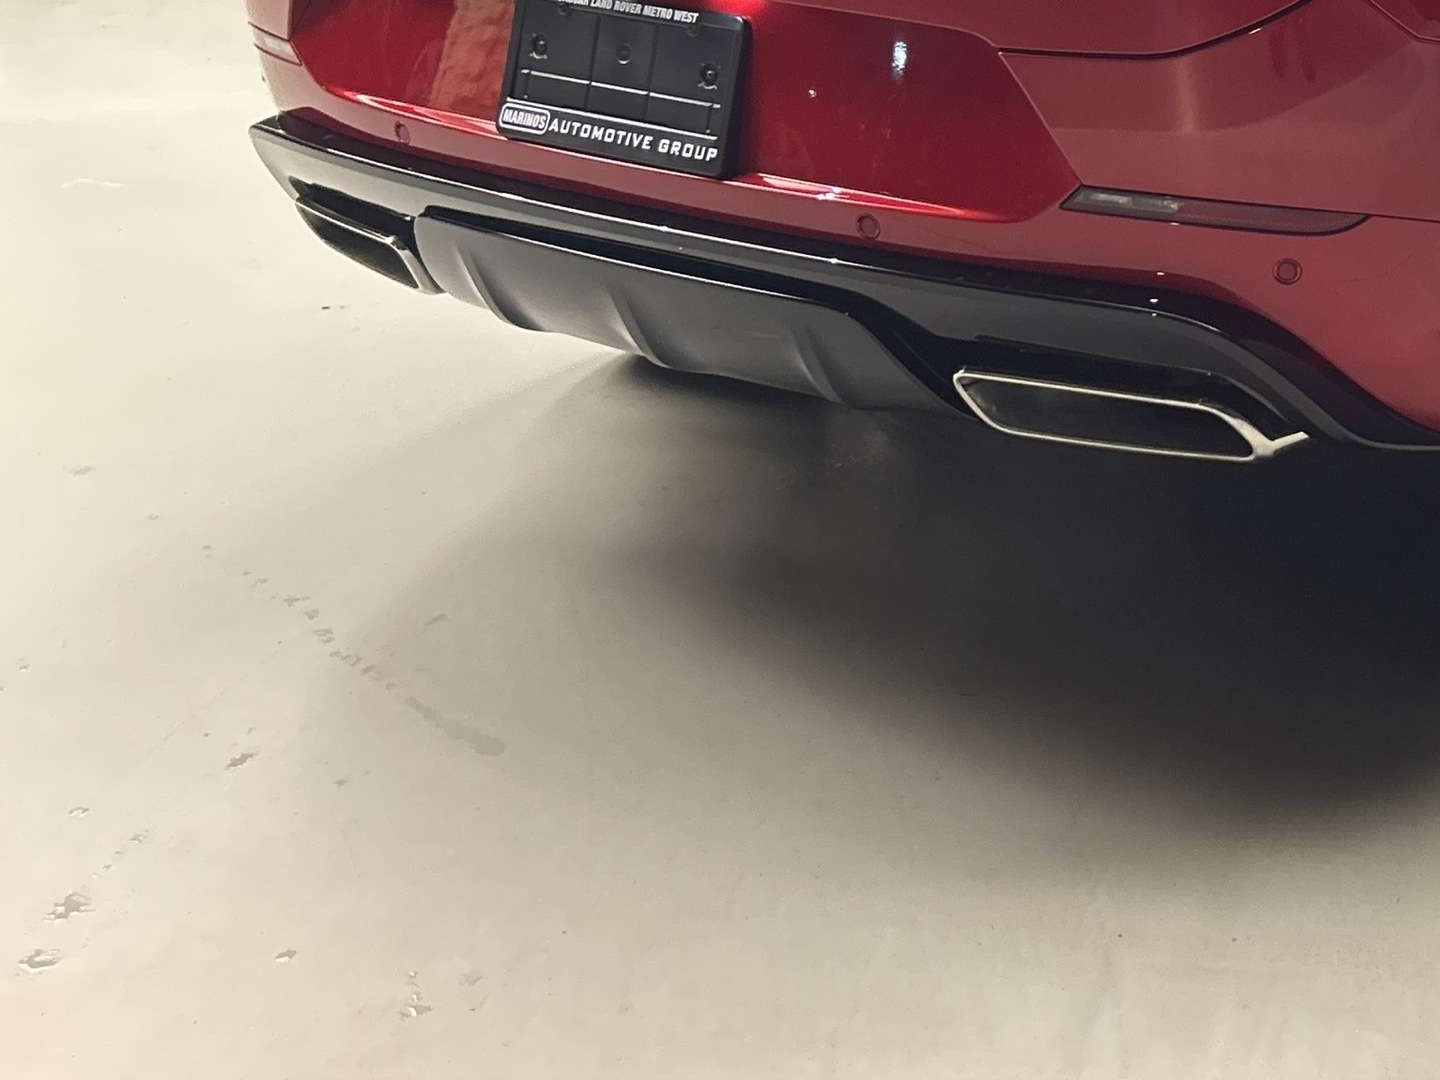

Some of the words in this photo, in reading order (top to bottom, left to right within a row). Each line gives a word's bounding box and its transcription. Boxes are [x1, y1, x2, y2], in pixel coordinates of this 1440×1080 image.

[613, 0, 642, 15] ROVER
[642, 4, 673, 20] METRO
[673, 9, 699, 24] WEST
[503, 108, 547, 130] MARINOS
[548, 118, 653, 150] AUTOMOTIVE
[658, 139, 718, 162] GROUP
